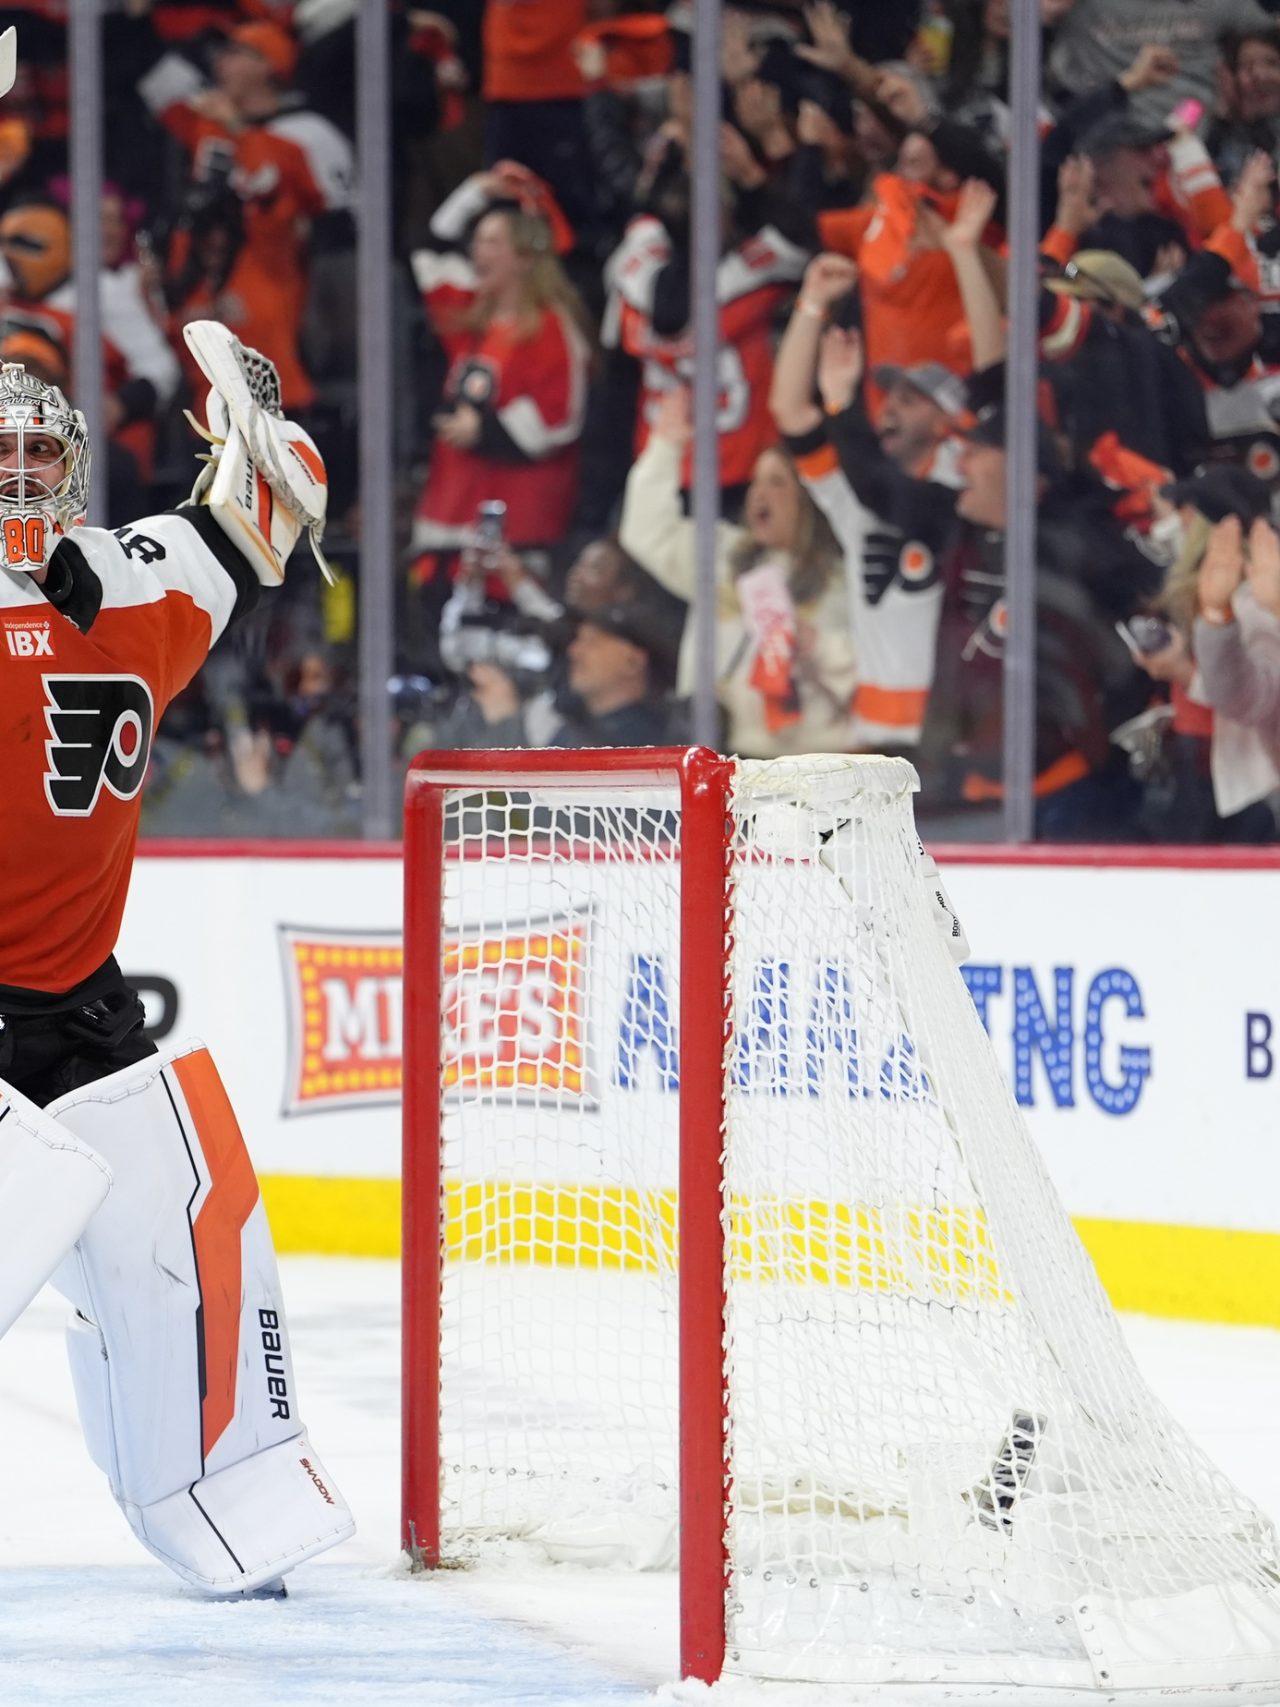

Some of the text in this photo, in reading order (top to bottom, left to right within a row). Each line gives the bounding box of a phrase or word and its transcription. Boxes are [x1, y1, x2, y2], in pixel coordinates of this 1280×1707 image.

[2, 516, 45, 565] 80
[5, 630, 54, 656] IBX
[258, 1308, 291, 1421] BAUER
[299, 1457, 335, 1505] SHADOW
